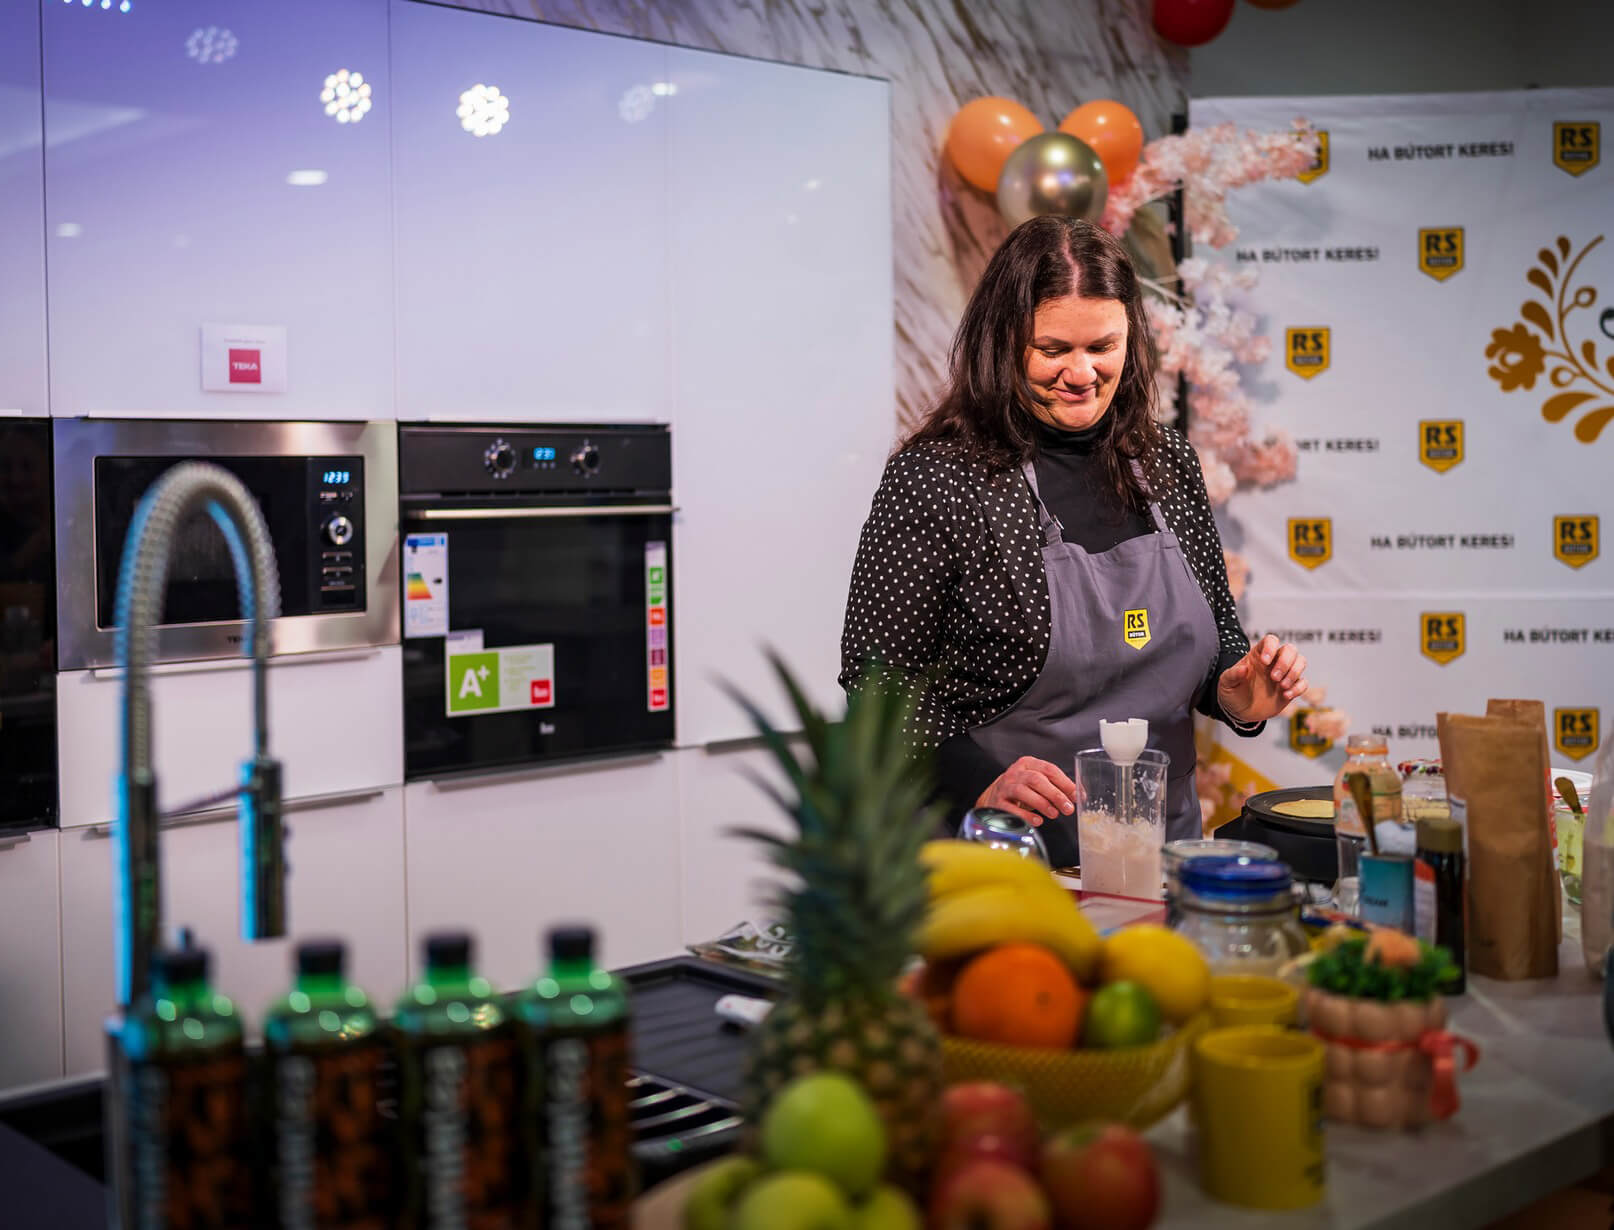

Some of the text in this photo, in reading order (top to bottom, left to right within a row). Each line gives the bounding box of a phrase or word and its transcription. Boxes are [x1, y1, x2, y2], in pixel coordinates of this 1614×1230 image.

[1561, 128, 1593, 148] RS
[1367, 145, 1390, 160] HA
[1426, 233, 1457, 253] RS
[1236, 248, 1258, 261] HA
[1292, 333, 1323, 352] RS
[1426, 427, 1457, 445] RS
[1295, 524, 1325, 542] RS
[1561, 521, 1593, 540] RS
[1370, 535, 1392, 549] HA
[1127, 613, 1145, 629] RS
[1428, 618, 1458, 637] RS
[1503, 629, 1525, 643] HA
[1398, 722, 1438, 740] BÚTO
[1561, 713, 1593, 732] RS
